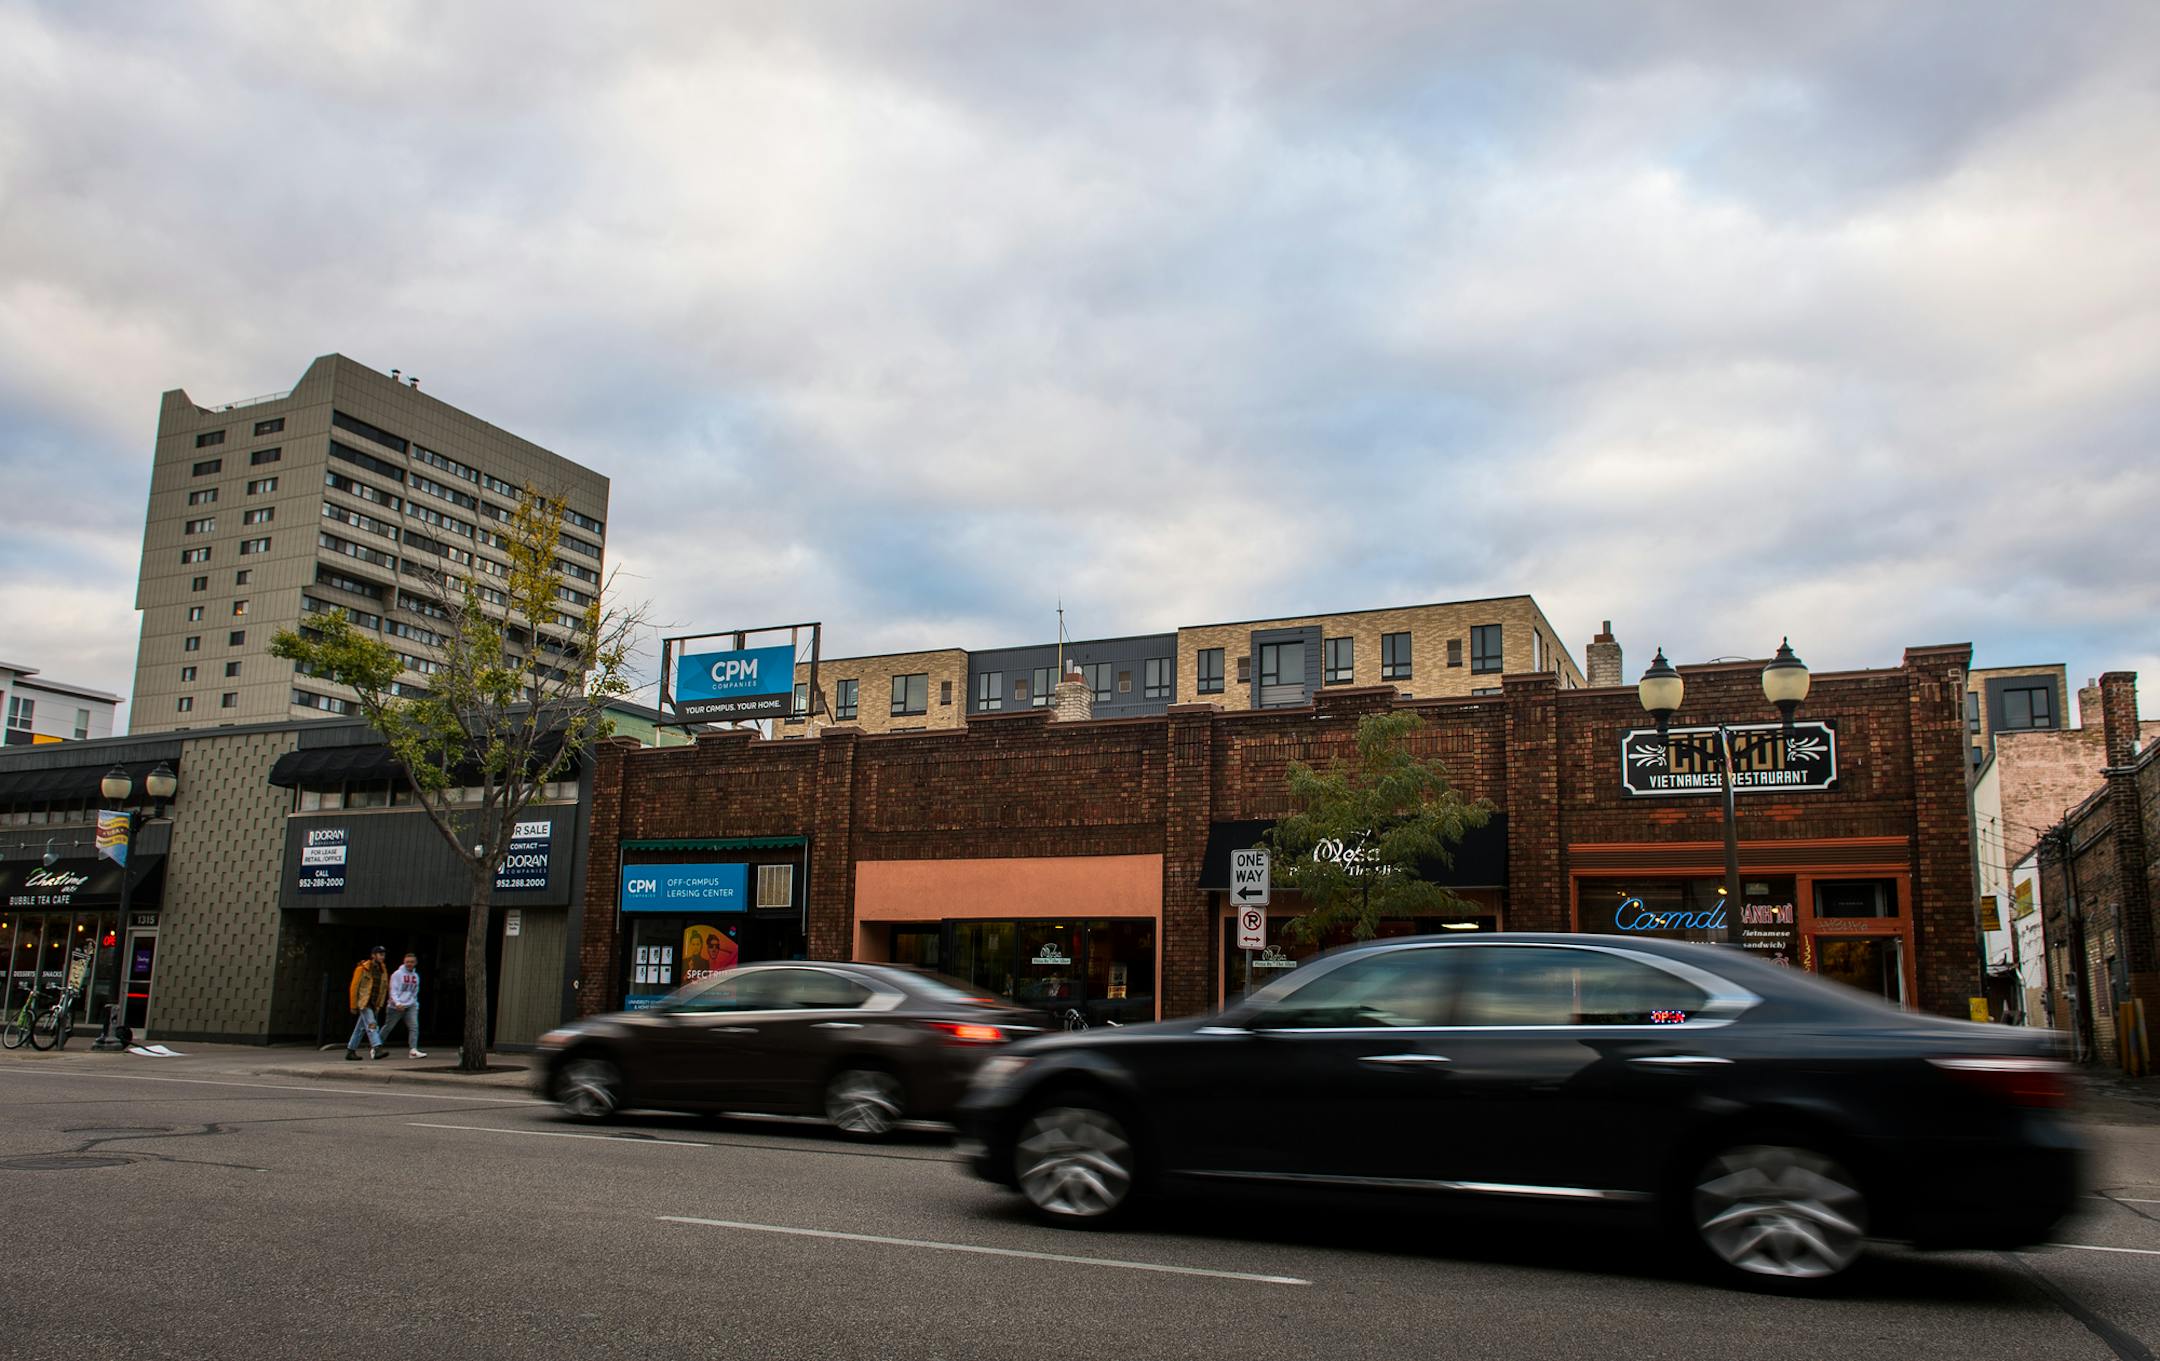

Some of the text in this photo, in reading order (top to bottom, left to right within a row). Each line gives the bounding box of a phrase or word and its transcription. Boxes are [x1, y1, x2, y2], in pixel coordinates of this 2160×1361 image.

[711, 658, 758, 682] CPM
[712, 680, 757, 690] COMPANIES
[685, 700, 781, 714] YOUR CAMPUS. YOUR HOME.
[1649, 769, 1808, 788] VIETNAMESE RESTAURANT
[523, 824, 548, 835] SALE
[315, 830, 344, 841] DORAN
[510, 842, 538, 850] CONTACT
[507, 854, 548, 868] DORAN
[1237, 854, 1264, 867] ONE
[1236, 870, 1264, 883] WAY
[299, 878, 344, 887] 952-288-2000
[496, 878, 546, 888] 952.288.2000
[628, 879, 656, 893] CPM
[667, 878, 719, 887] OFF-CAMPUS
[667, 888, 734, 898] LEASING CENTER
[9, 895, 70, 906] BUBBLE TEA CAFE
[137, 915, 155, 925] 1315
[103, 935, 116, 946] OPE
[687, 970, 736, 980] SPECTRU
